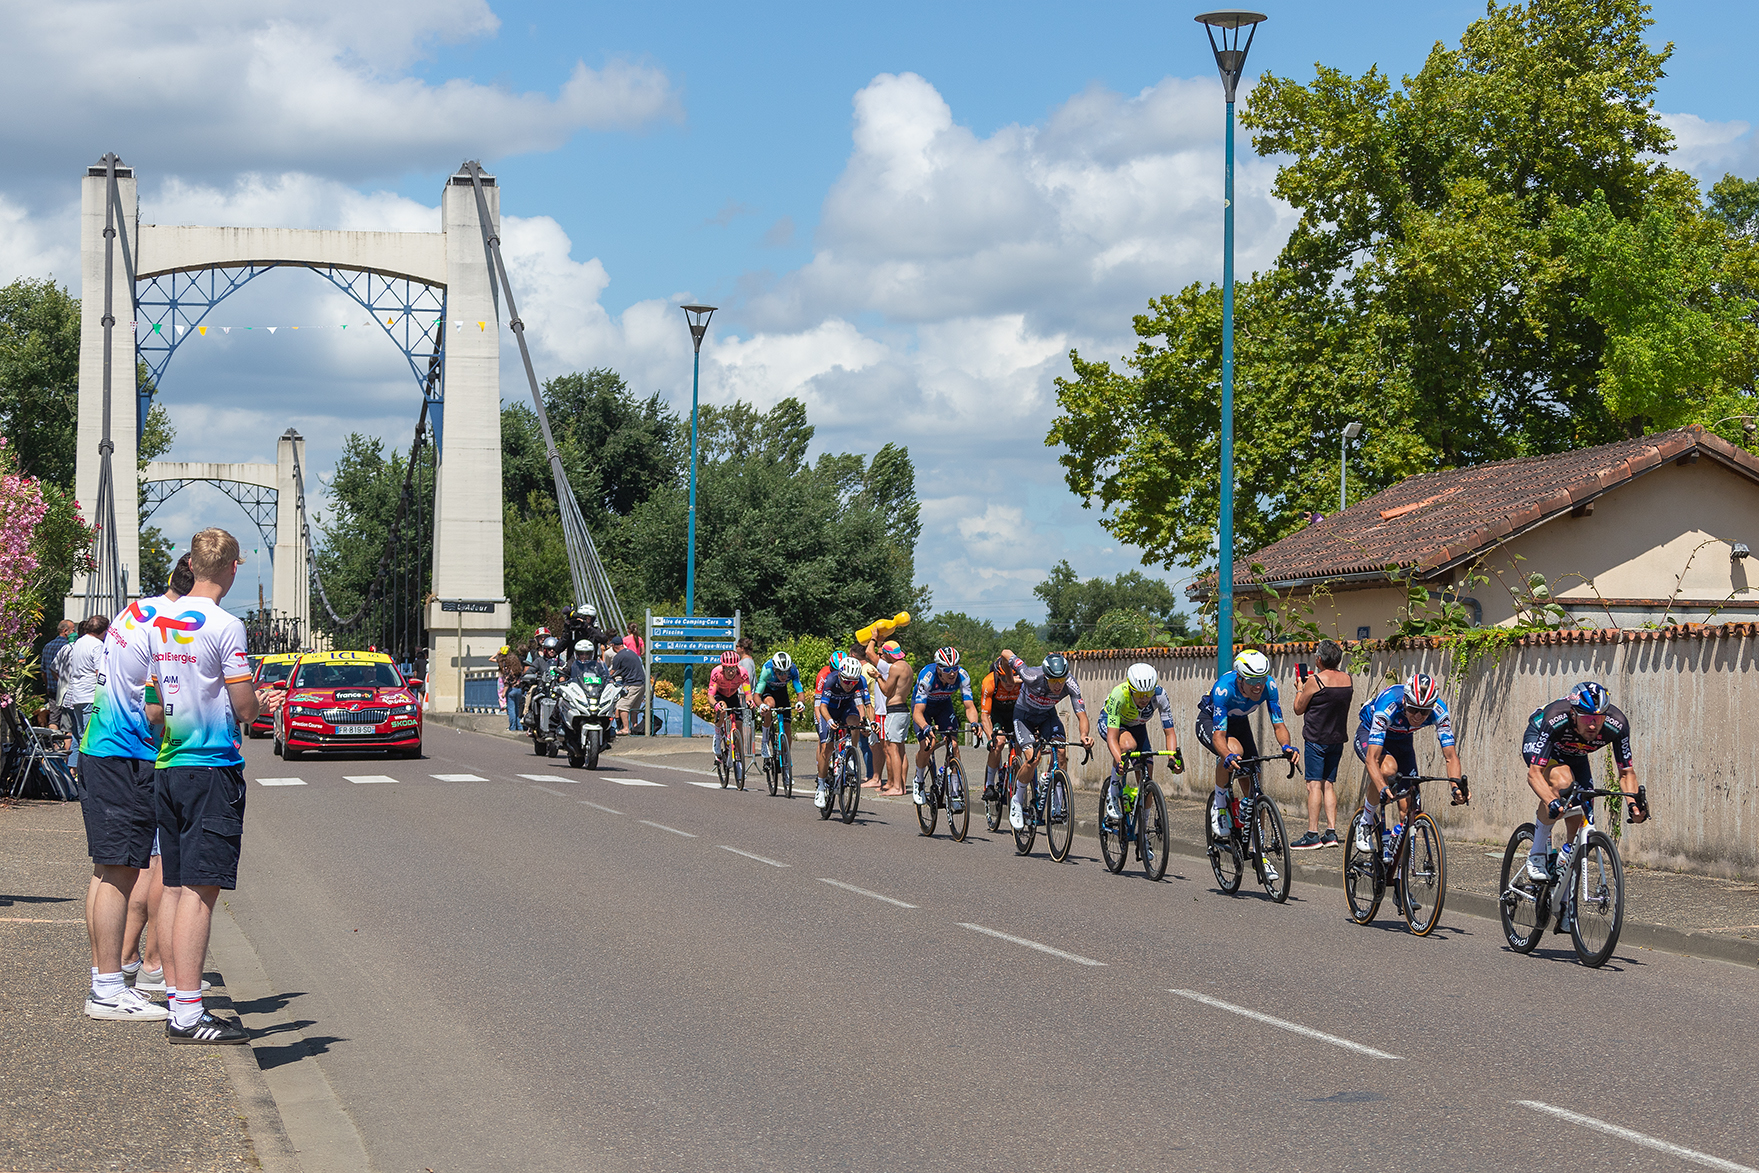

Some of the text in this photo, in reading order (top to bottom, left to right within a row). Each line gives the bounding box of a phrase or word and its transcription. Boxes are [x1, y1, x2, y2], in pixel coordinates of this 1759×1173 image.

[331, 652, 361, 660] LCL
[1549, 713, 1568, 726] BORA
[1605, 716, 1624, 731] BORA
[1533, 732, 1549, 754] BOSS
[1621, 737, 1632, 759] BOSS
[1242, 798, 1254, 843] CANYON
